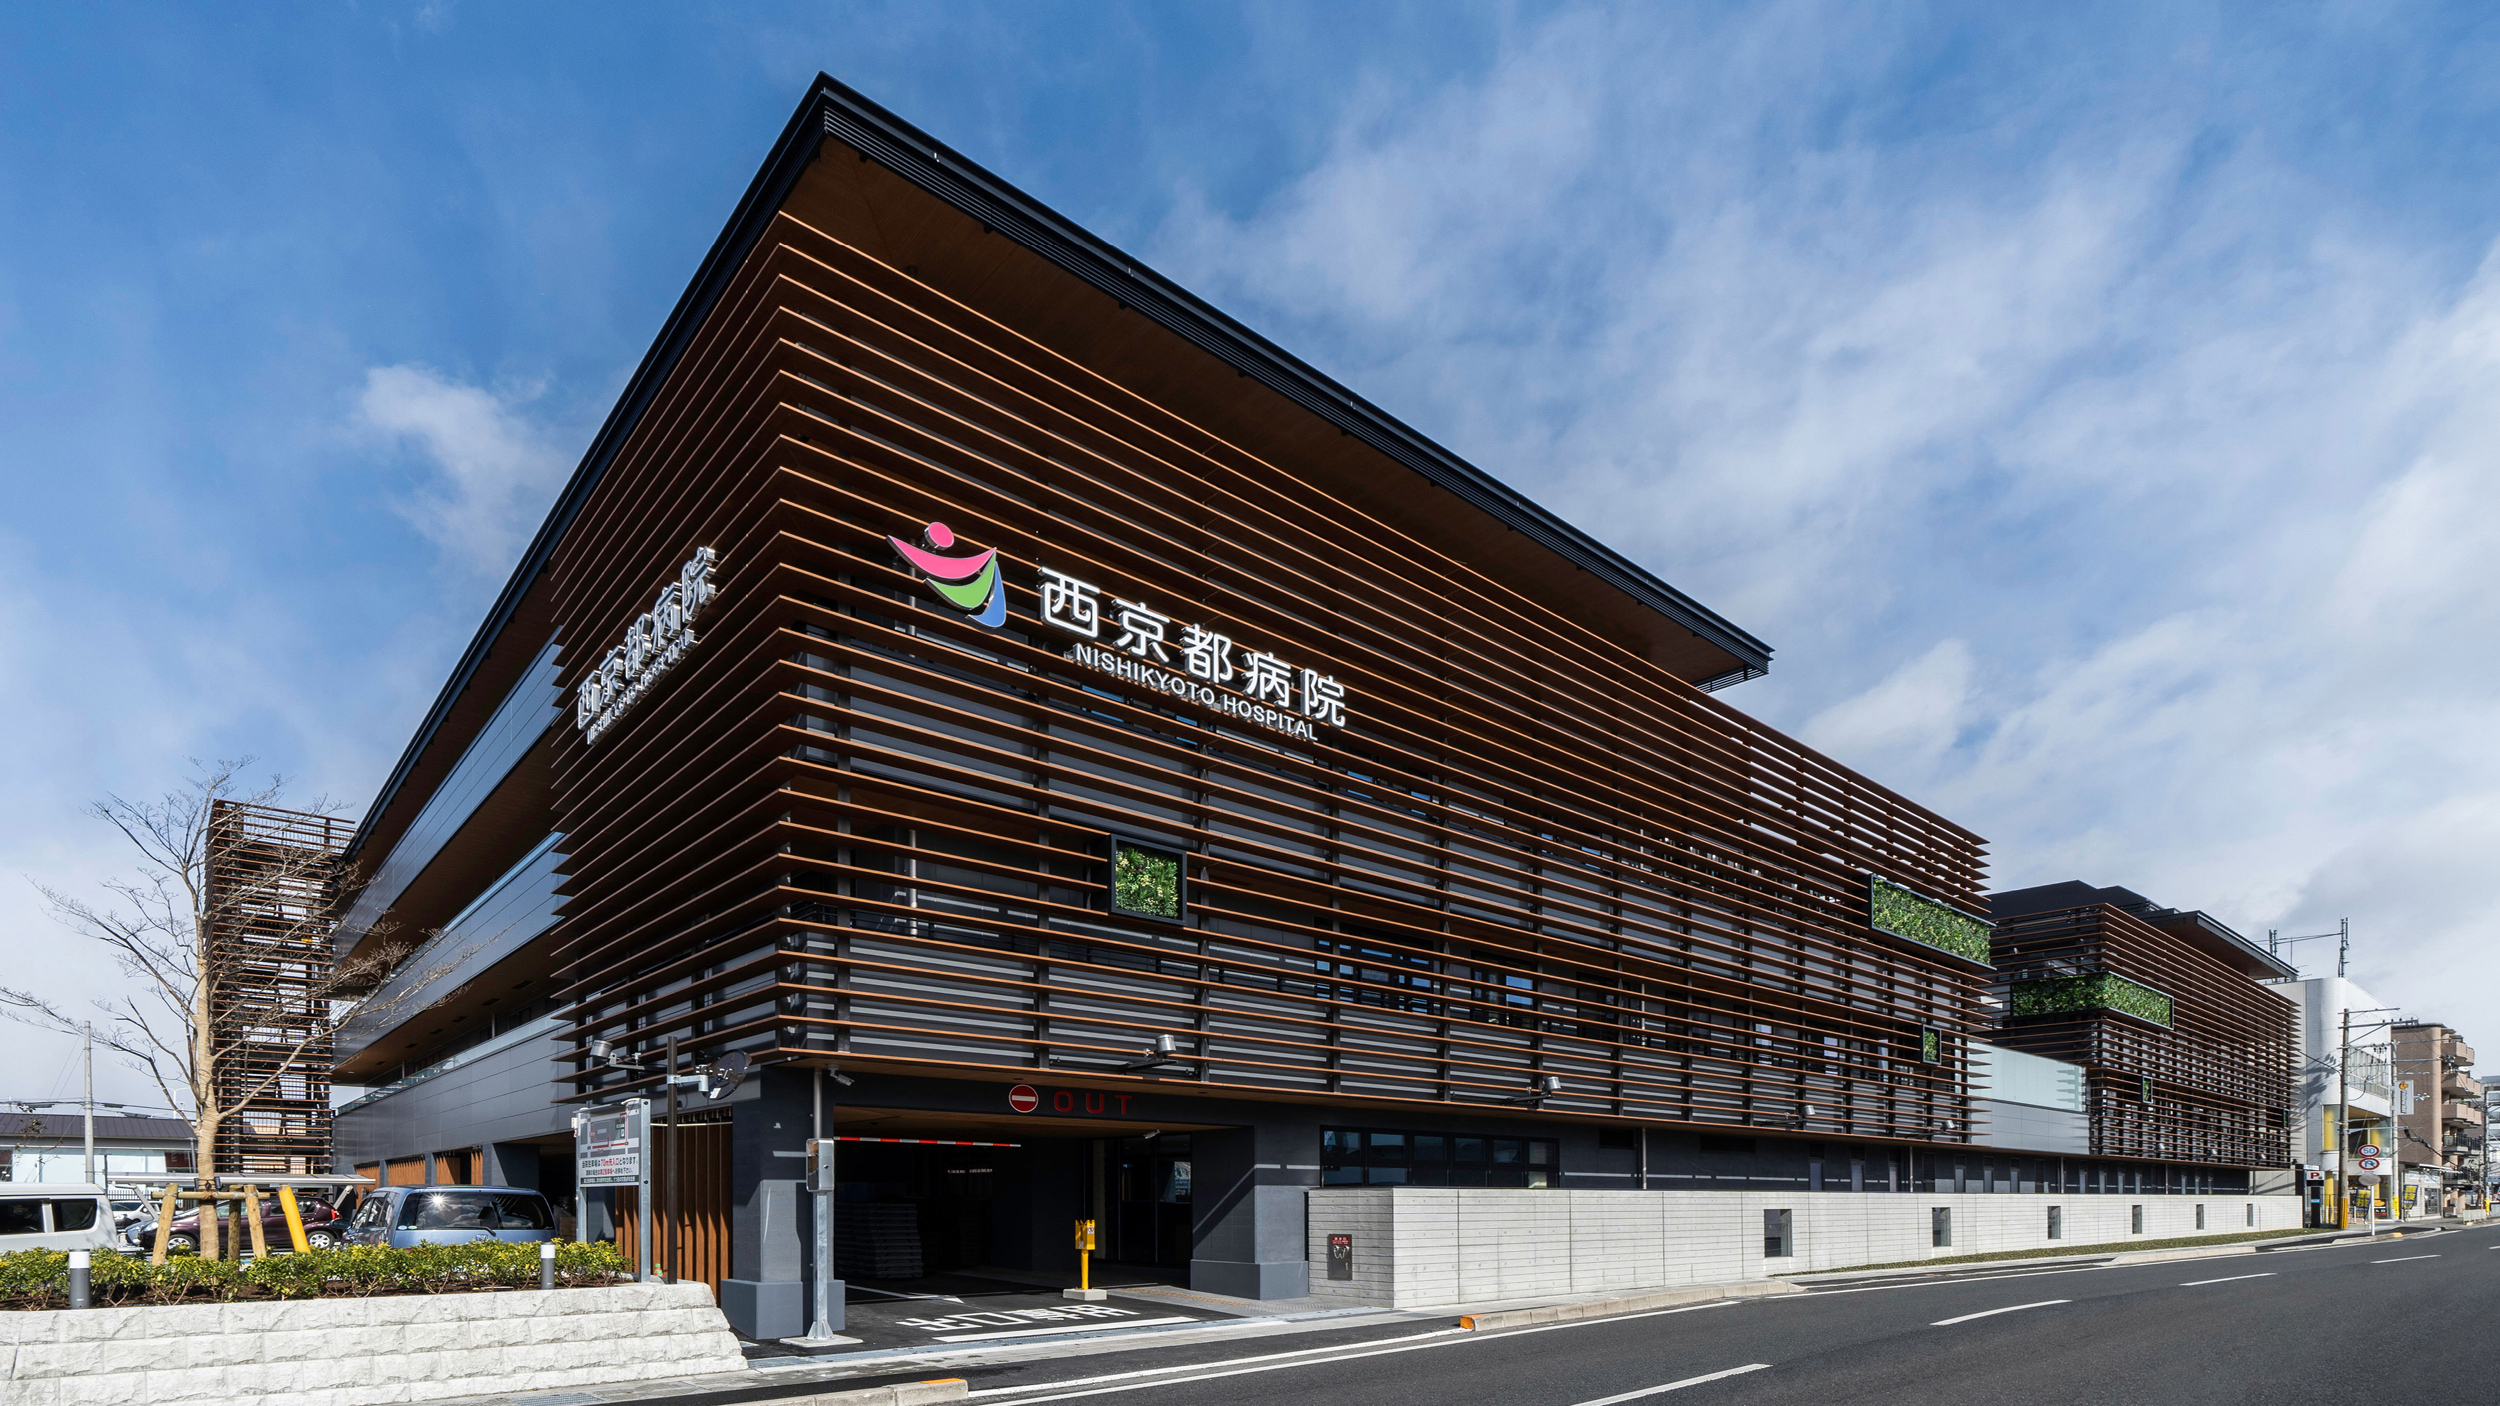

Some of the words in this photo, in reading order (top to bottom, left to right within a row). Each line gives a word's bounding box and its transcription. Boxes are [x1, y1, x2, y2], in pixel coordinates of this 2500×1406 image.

[1038, 566, 1346, 728] 西京都病院
[1072, 642, 1216, 707] NISHIKYOTO
[1221, 693, 1319, 742] HOSPITAL
[1053, 1090, 1133, 1115] OUT
[2362, 1147, 2376, 1155] 50
[895, 1304, 1141, 1331] 出口専用
